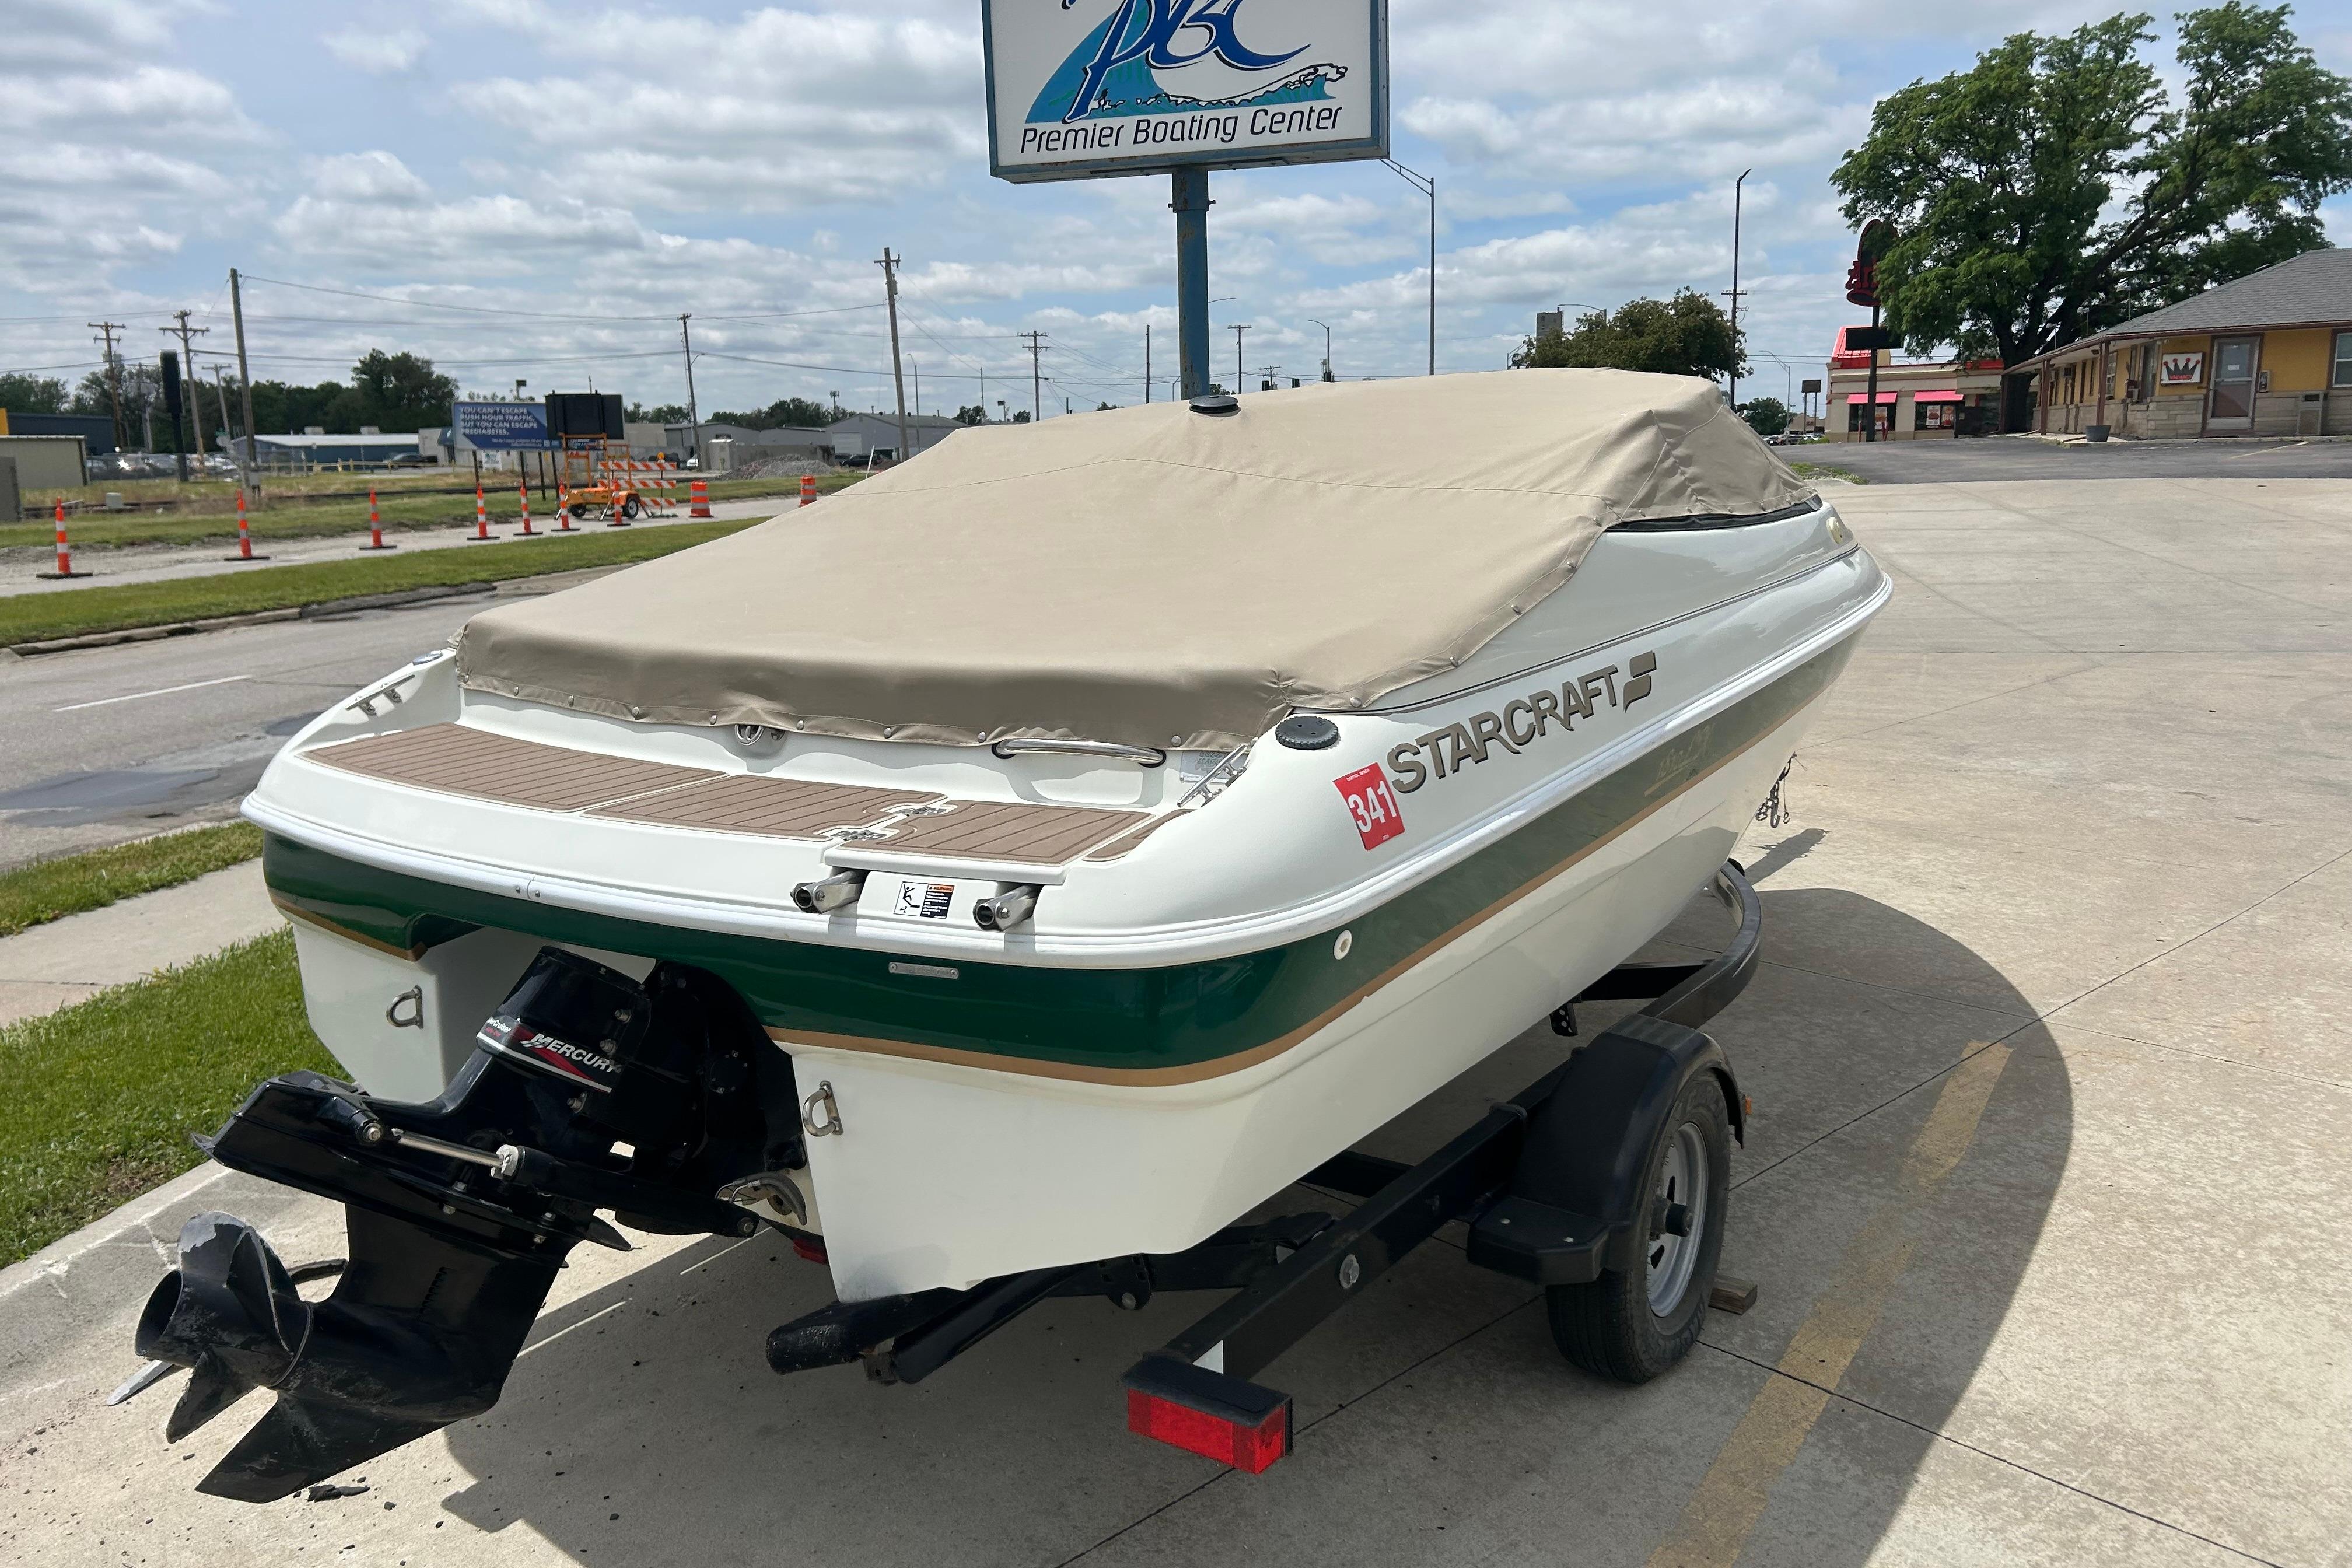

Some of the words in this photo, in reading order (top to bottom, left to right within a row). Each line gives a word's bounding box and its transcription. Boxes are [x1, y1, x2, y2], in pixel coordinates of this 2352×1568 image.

[1021, 123, 1124, 153] Premier
[1133, 115, 1238, 143] Boating
[1250, 107, 1342, 135] Center
[1387, 664, 1618, 793] STARCRAFT
[1348, 780, 1397, 833] 341
[530, 1033, 622, 1073] MERCURY
